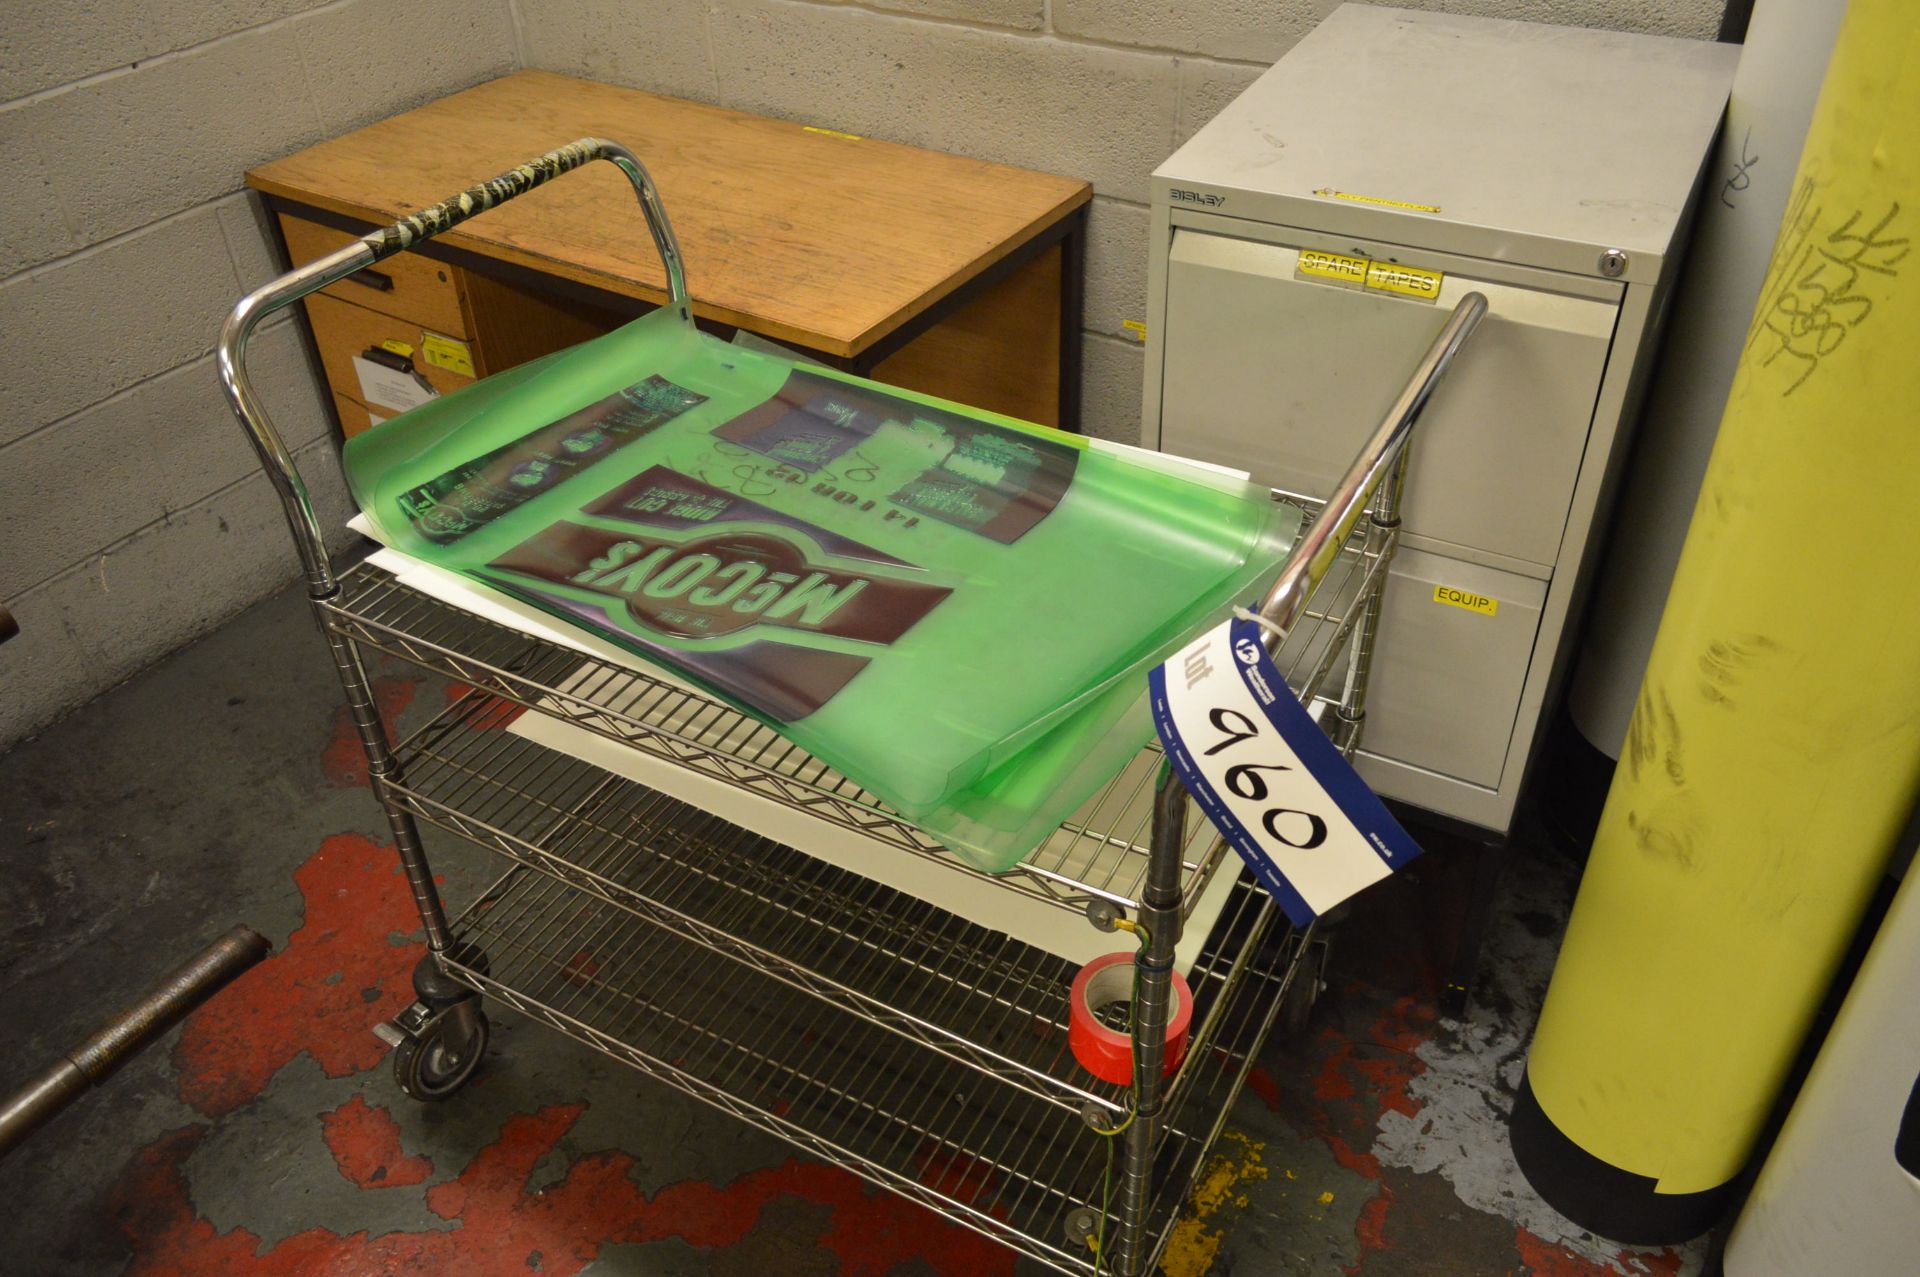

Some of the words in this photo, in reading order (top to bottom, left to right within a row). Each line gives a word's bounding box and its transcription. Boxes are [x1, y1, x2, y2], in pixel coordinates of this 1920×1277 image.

[1170, 188, 1225, 208] BISLEY
[1303, 253, 1363, 276] SPARE
[1375, 267, 1434, 292] TAPES
[1438, 587, 1492, 612] EQUIP.
[1183, 642, 1214, 690] Lot
[1204, 708, 1328, 850] 960
